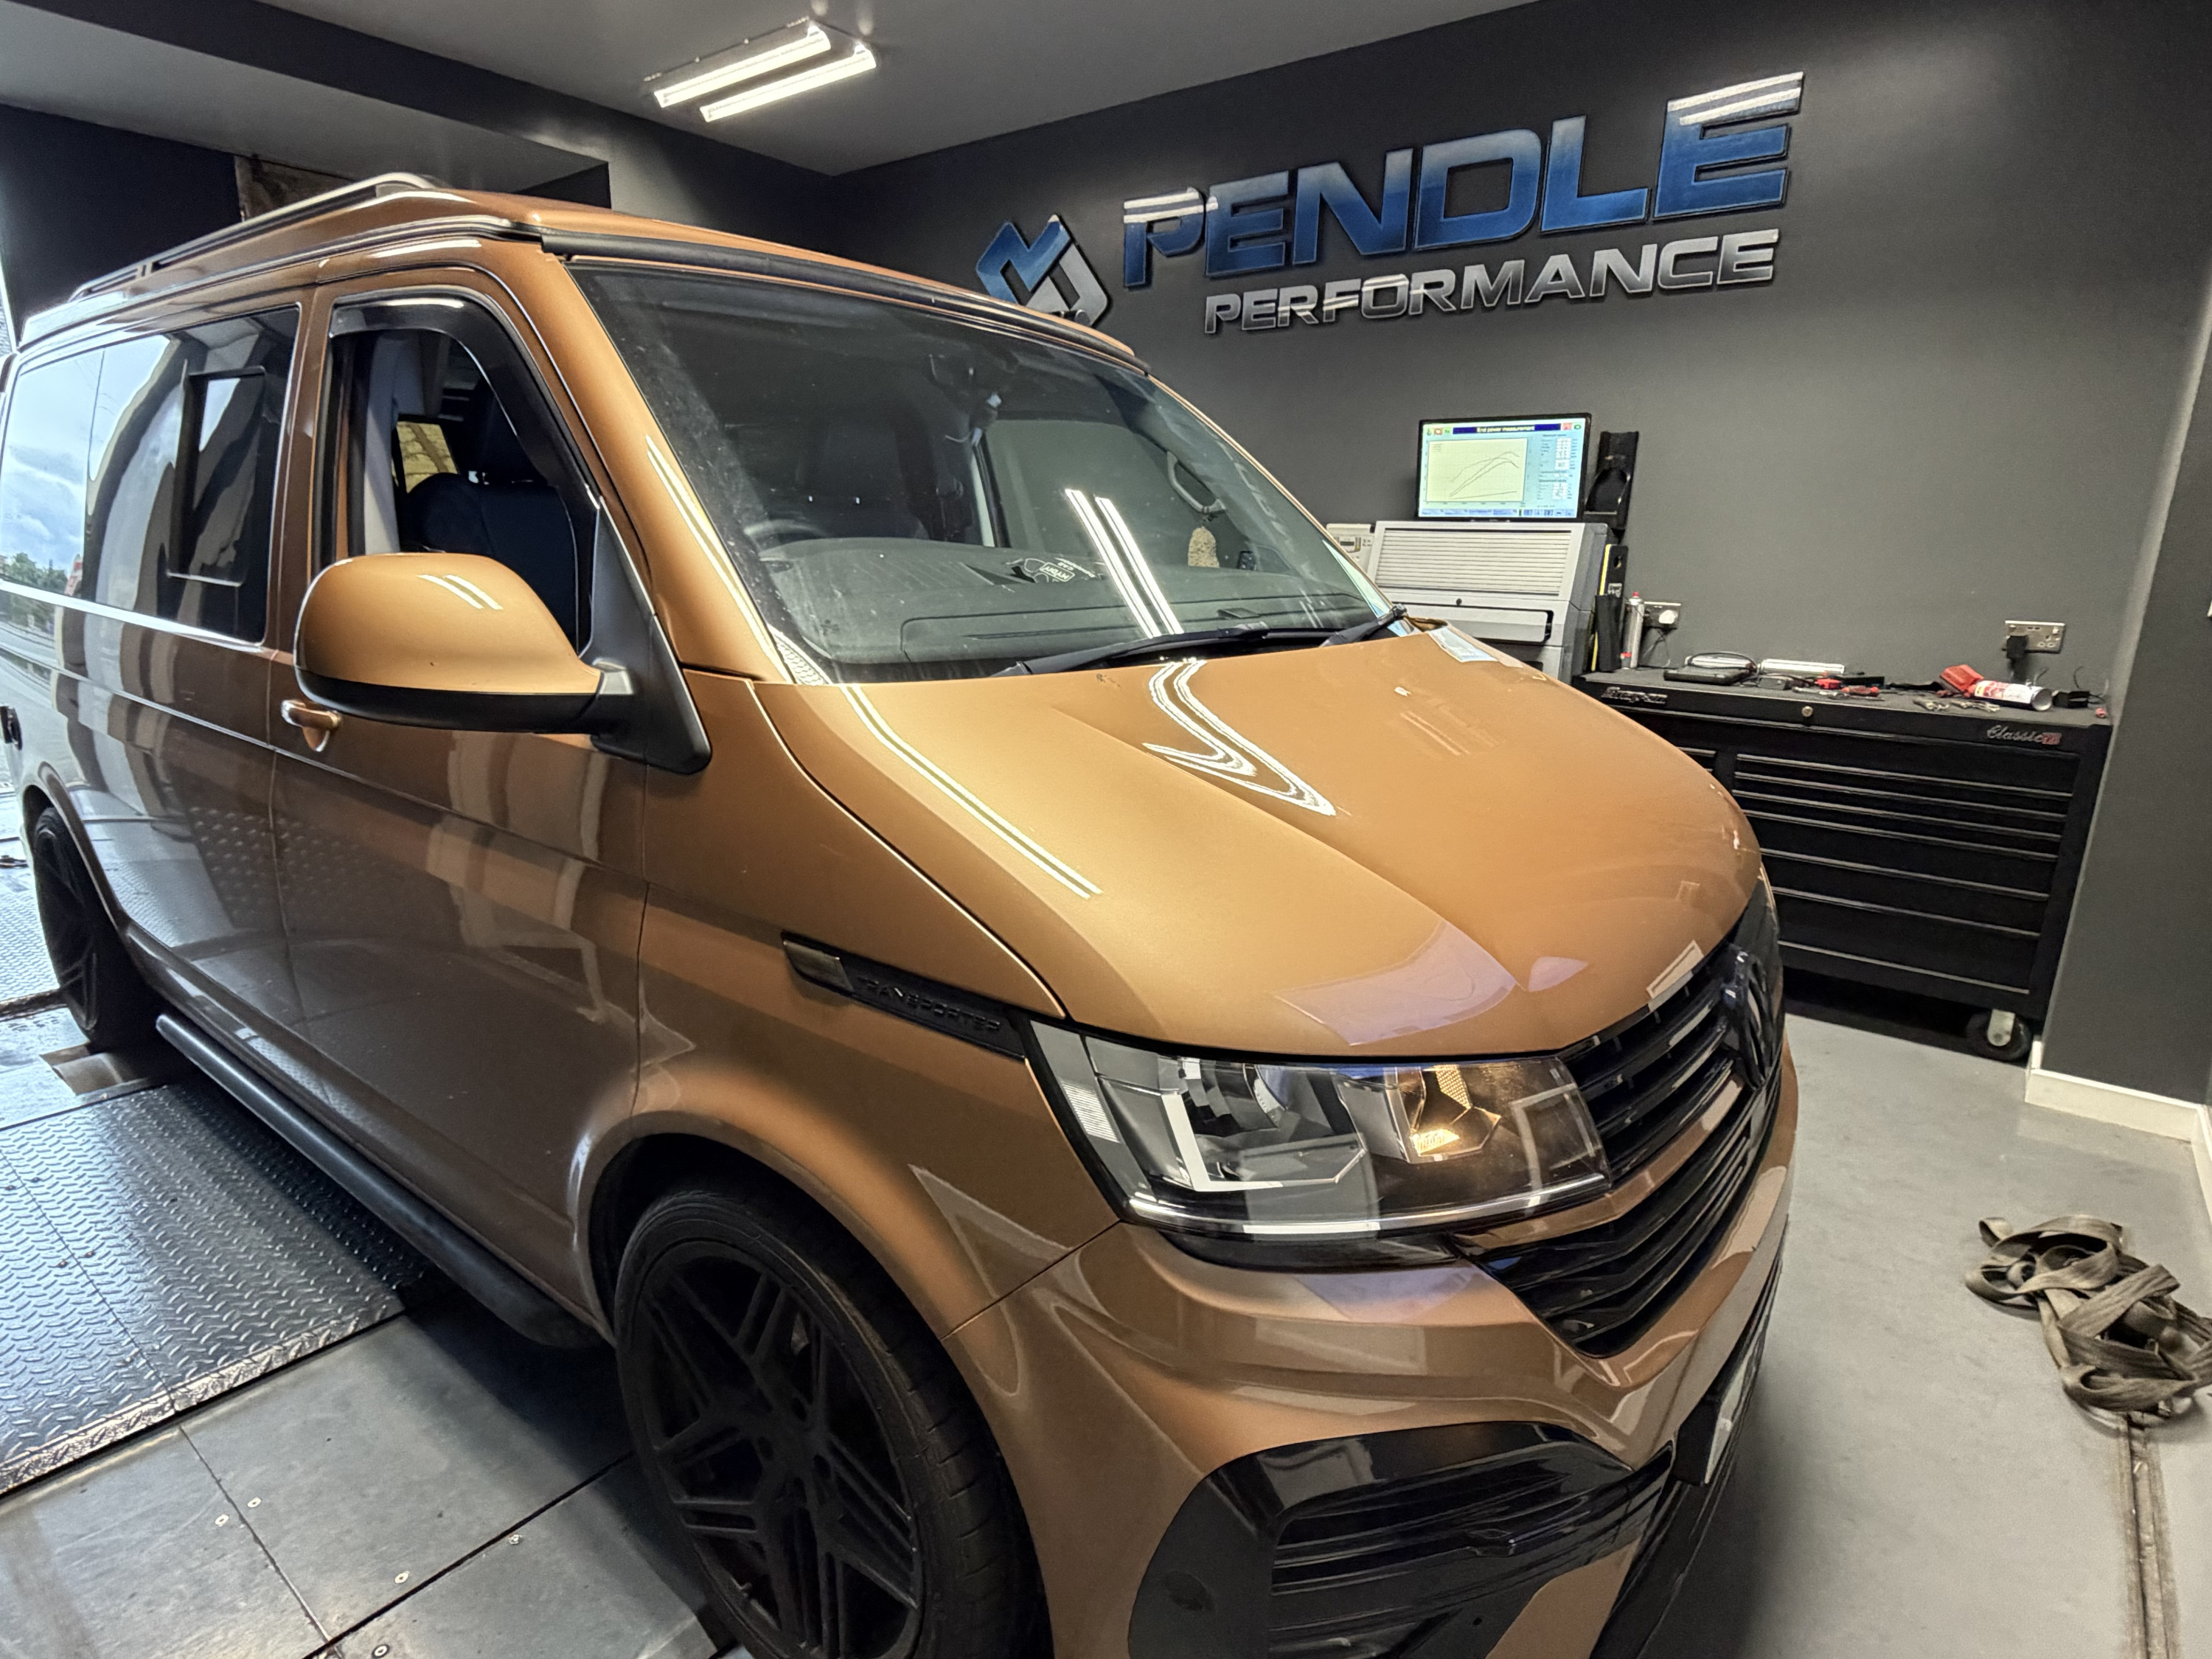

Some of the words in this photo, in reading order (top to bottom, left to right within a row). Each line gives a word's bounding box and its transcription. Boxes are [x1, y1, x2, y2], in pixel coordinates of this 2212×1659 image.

[1123, 71, 1804, 288] PENDLE
[1205, 229, 1779, 335] PERFORMANCE
[1987, 724, 2042, 743] Classic
